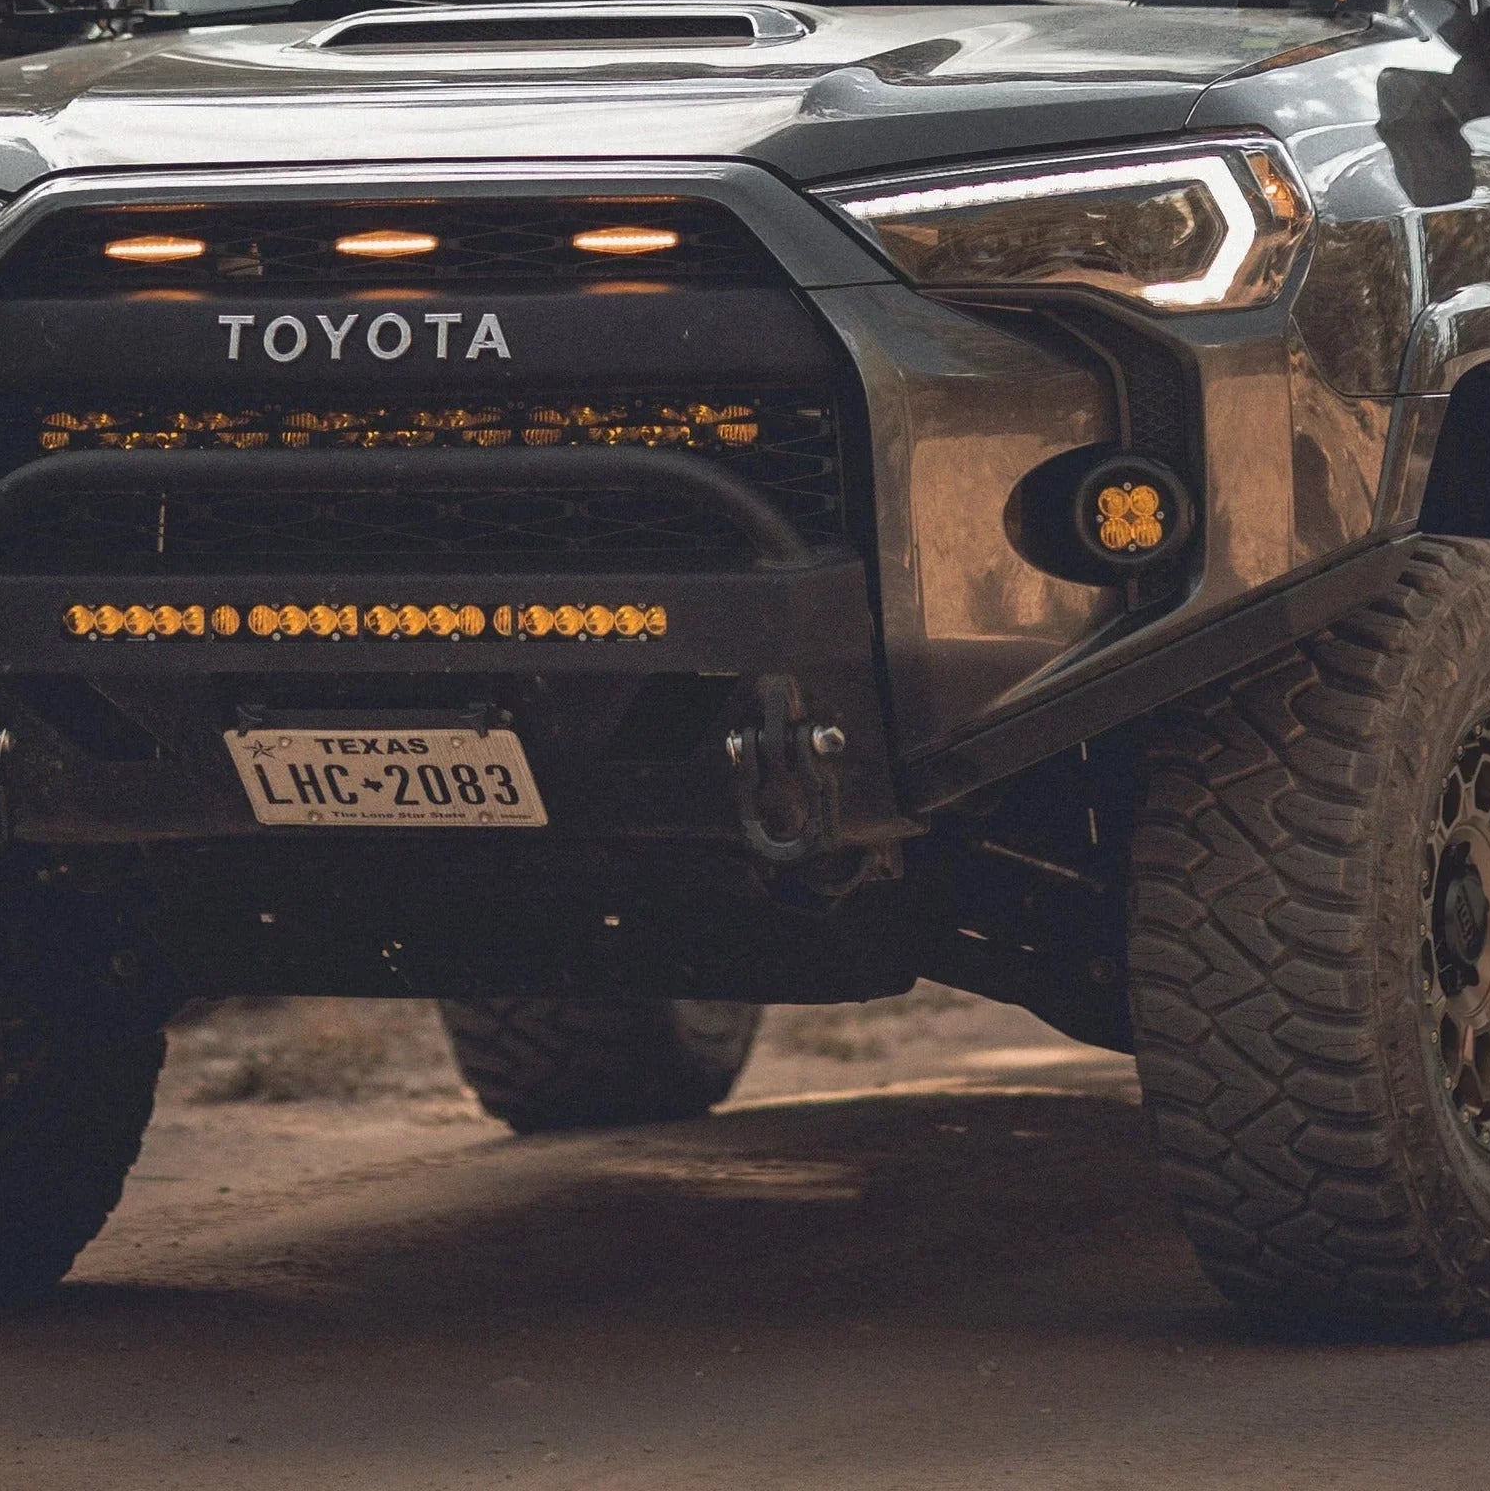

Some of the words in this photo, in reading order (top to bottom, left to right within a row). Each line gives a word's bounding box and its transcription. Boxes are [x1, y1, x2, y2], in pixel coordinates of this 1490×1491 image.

[218, 312, 512, 362] TOYOTA
[314, 738, 429, 755] TEXAS
[331, 811, 357, 819] The
